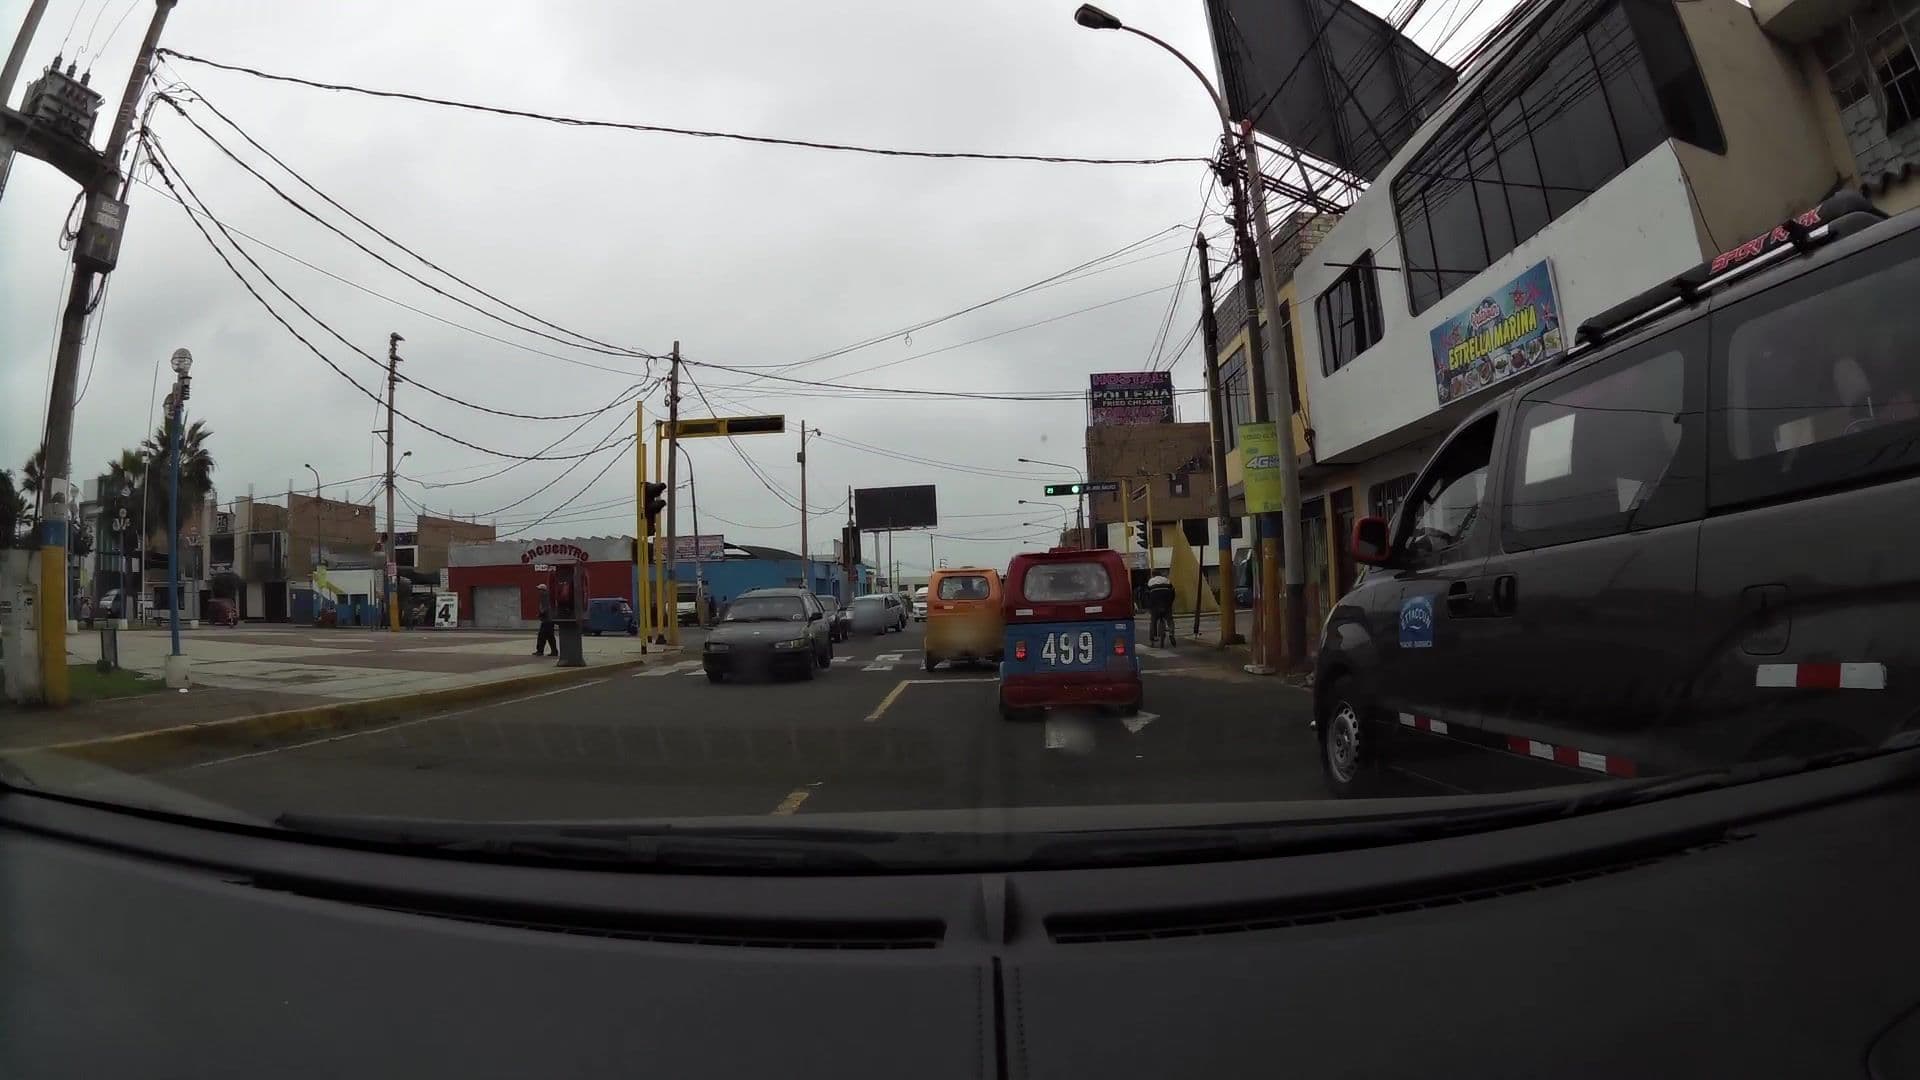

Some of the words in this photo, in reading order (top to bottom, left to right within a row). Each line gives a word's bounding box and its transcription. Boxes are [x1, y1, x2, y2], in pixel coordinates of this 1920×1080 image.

[1711, 232, 1770, 274] SPORT
[1770, 204, 1823, 244] RCK
[1449, 330, 1494, 370] ESTRELLA
[1494, 305, 1537, 349] MARINA
[1042, 632, 1093, 665] 499
